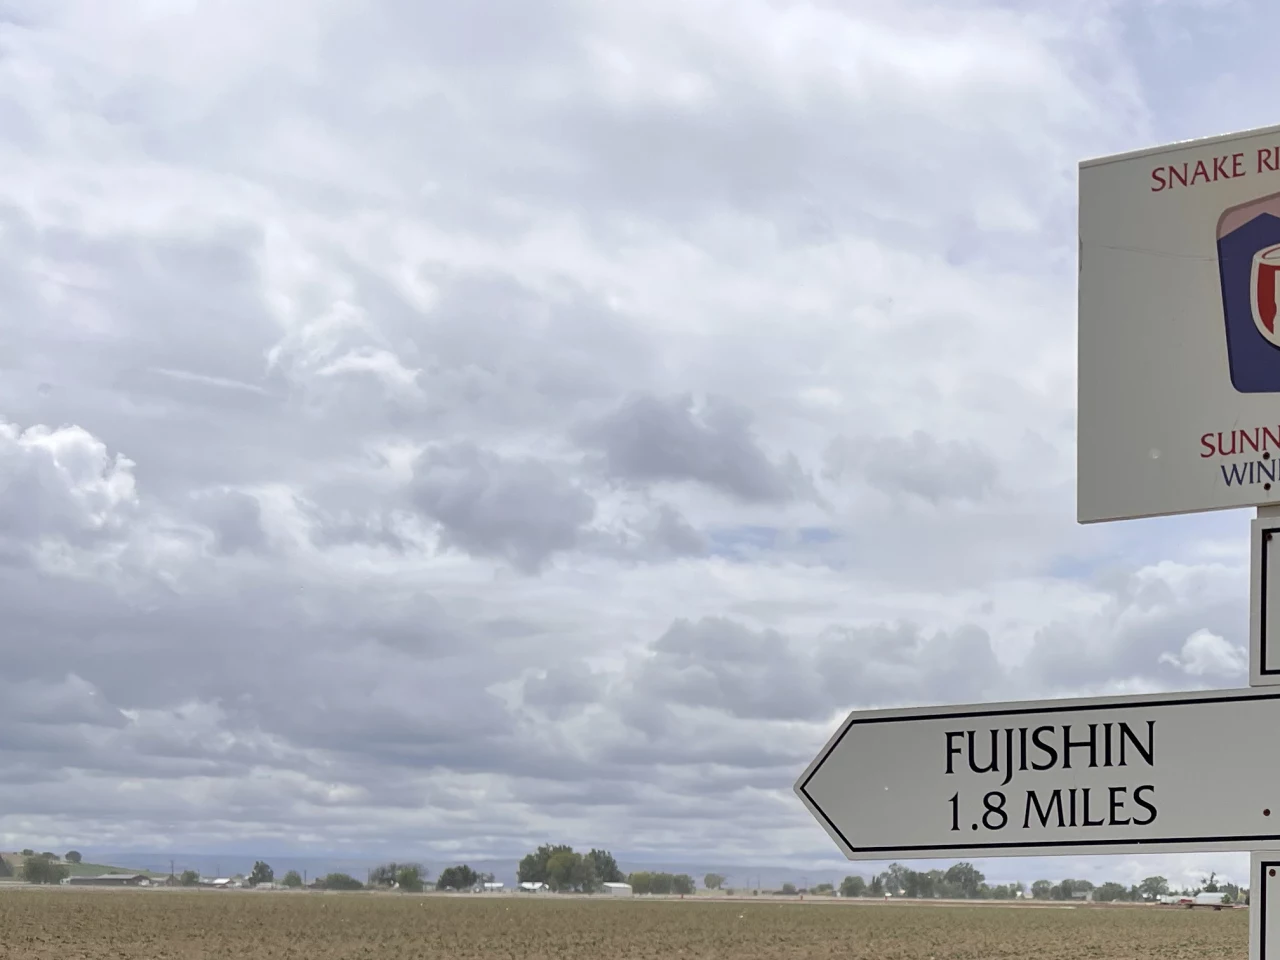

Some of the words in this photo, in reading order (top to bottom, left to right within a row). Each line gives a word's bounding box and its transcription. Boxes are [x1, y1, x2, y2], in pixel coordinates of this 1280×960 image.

[1151, 153, 1246, 192] SNAKE
[944, 720, 1157, 787] FUJISHIN
[948, 791, 1009, 832] 1.8
[1021, 784, 1158, 829] MILES
